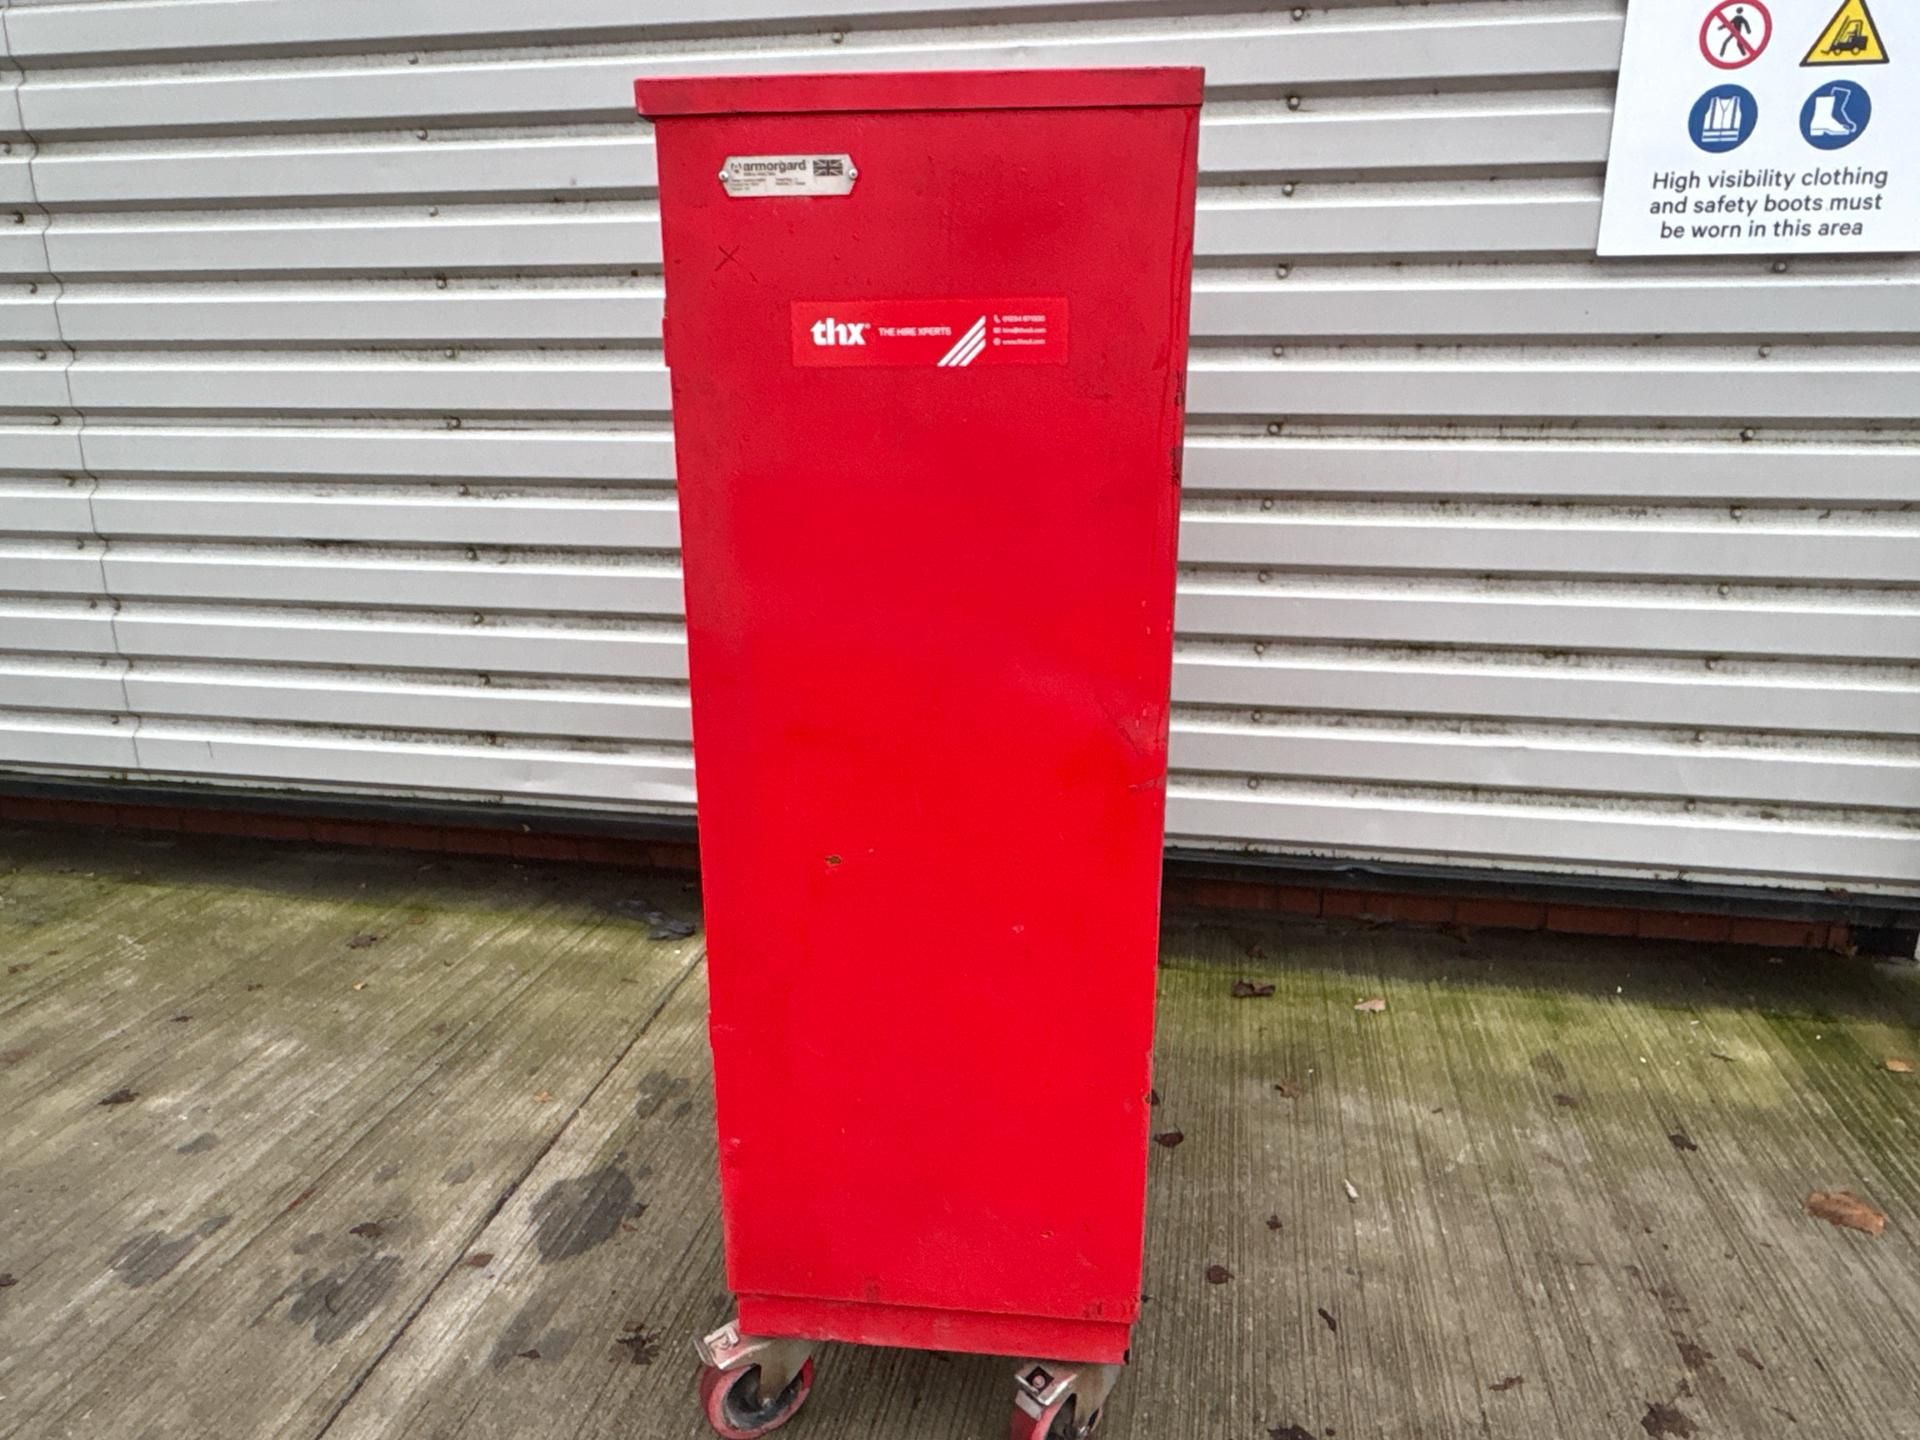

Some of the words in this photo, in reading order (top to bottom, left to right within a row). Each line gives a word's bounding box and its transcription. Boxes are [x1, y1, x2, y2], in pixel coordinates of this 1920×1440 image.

[743, 159, 807, 174] armorgard
[1652, 170, 1701, 194] High
[1708, 168, 1796, 192] visibility
[1801, 166, 1889, 190] clothing
[1649, 195, 1688, 214] and
[1693, 194, 1759, 217] safety
[1764, 193, 1824, 213] boots
[1830, 193, 1884, 211] must
[1660, 220, 1686, 239] be
[1691, 224, 1742, 239] worn
[1748, 219, 1767, 238] in
[1773, 218, 1812, 238] this
[1818, 221, 1864, 237] area
[809, 316, 866, 347] thx
[878, 327, 896, 337] THE
[896, 327, 917, 337] HIRE
[917, 326, 952, 337] XPERTS
